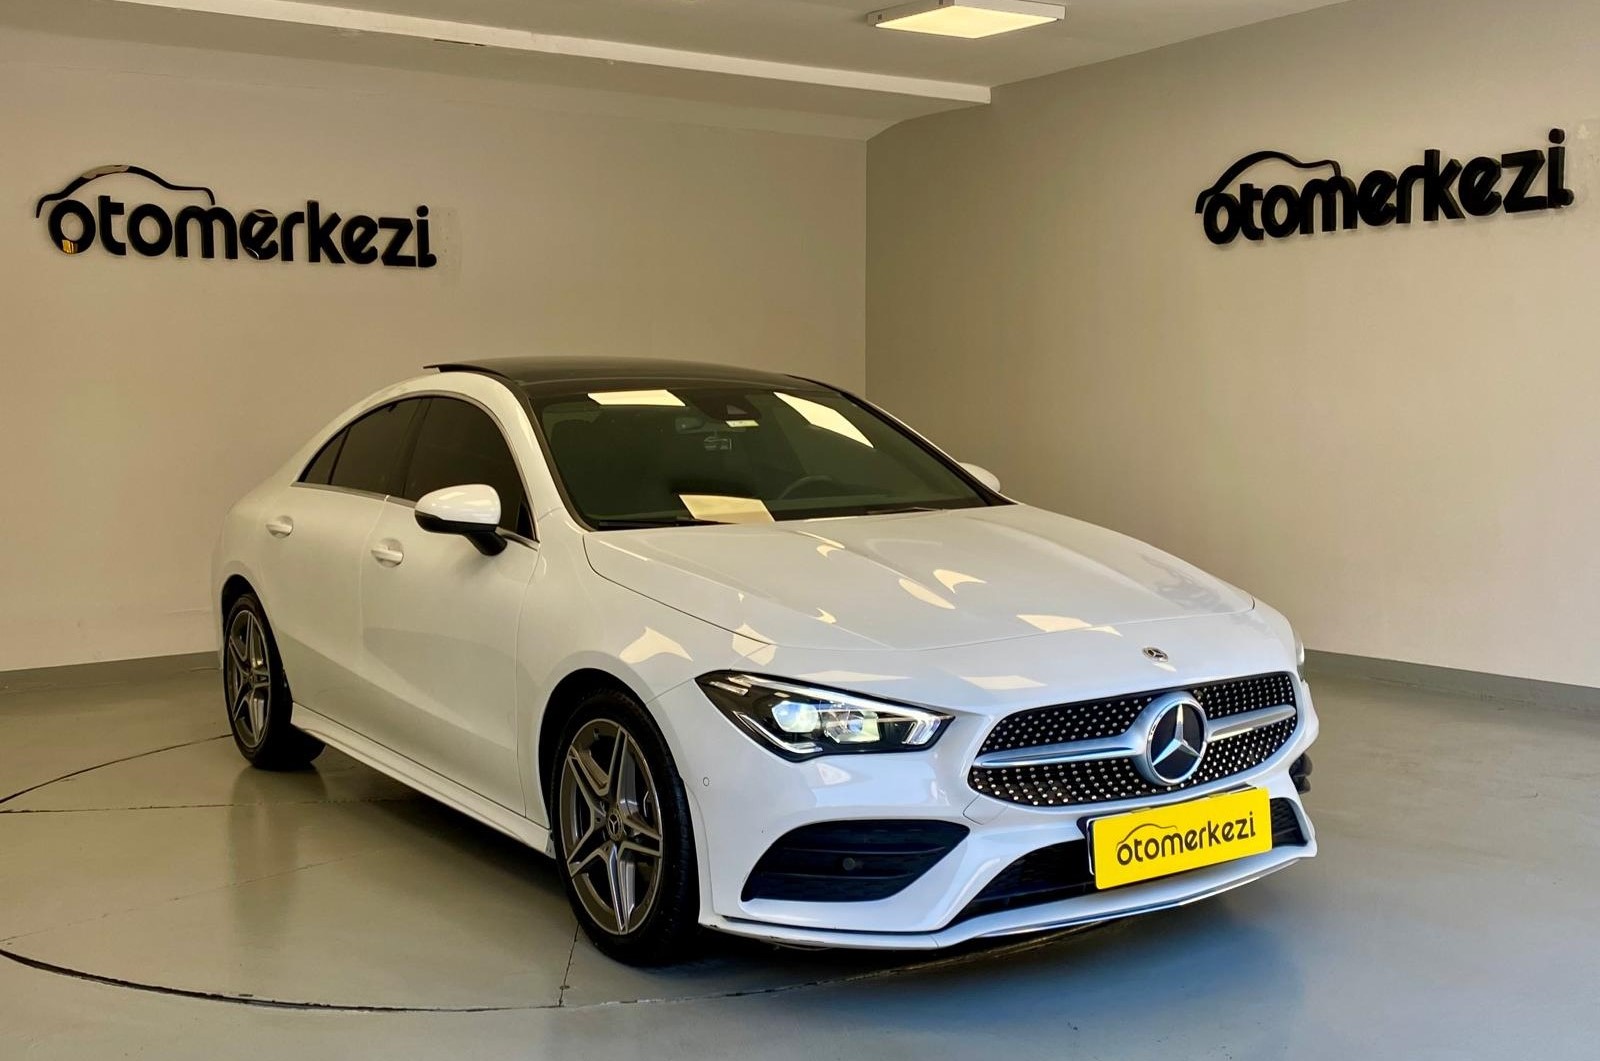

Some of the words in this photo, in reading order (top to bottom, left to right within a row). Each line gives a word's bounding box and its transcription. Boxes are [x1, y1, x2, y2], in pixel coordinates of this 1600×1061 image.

[1203, 128, 1574, 245] otomerkezi
[48, 195, 437, 268] otomerkezi
[1117, 811, 1256, 866] otomerkezi
